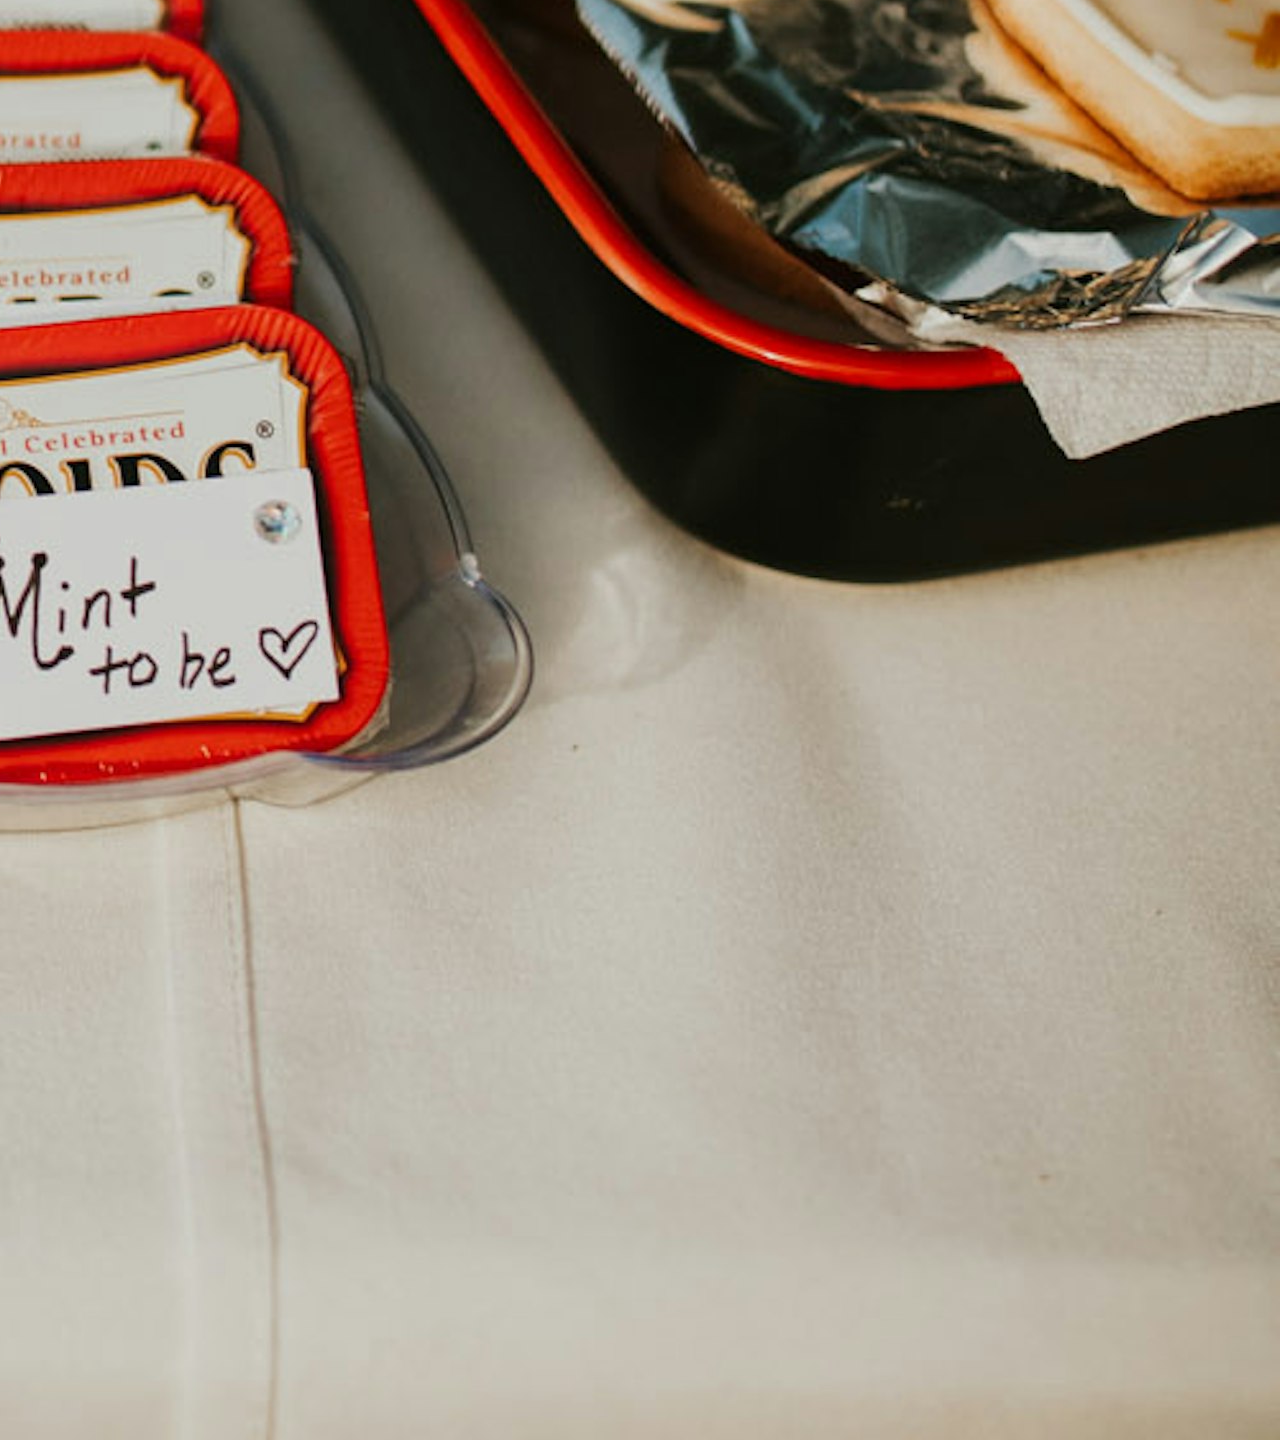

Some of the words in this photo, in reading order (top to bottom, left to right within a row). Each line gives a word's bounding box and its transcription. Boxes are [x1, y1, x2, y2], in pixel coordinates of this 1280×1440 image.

[23, 420, 187, 454] Celebrated
[88, 642, 160, 696] to
[178, 629, 238, 690] be
